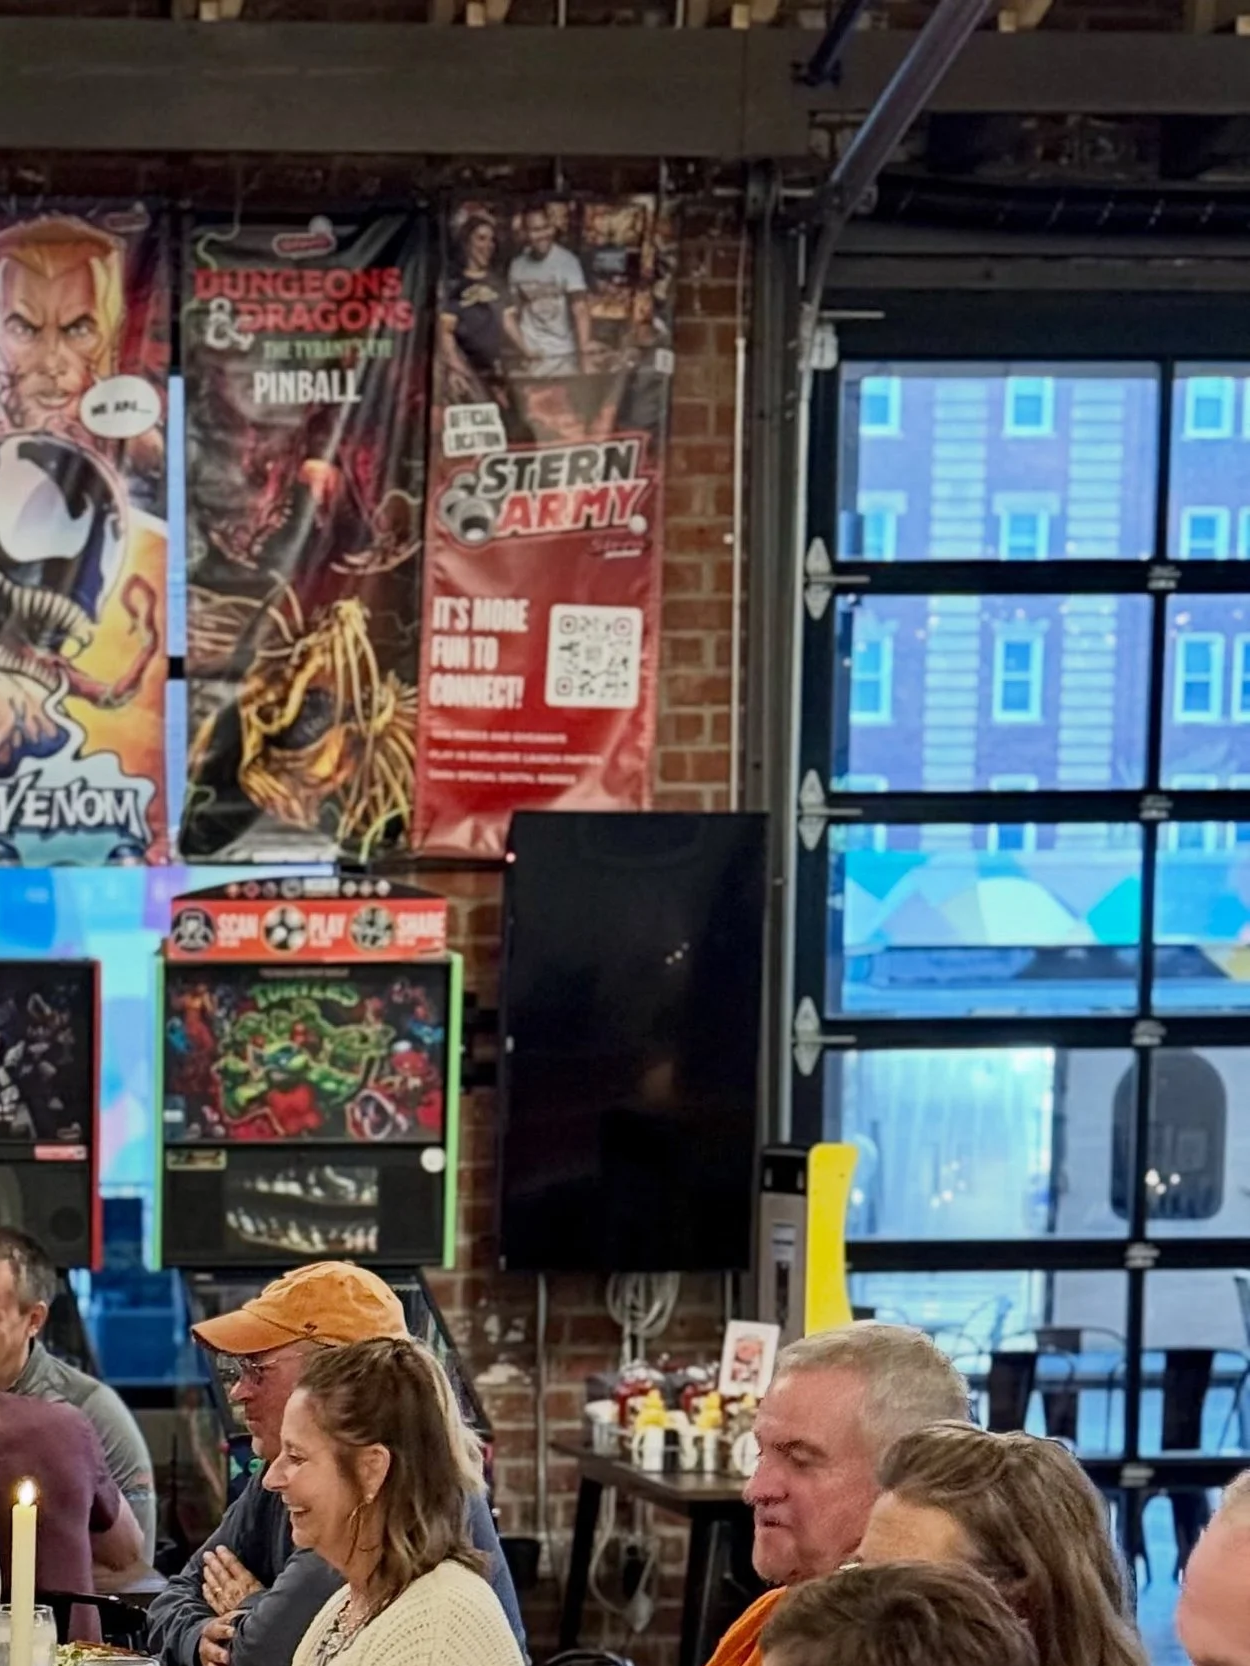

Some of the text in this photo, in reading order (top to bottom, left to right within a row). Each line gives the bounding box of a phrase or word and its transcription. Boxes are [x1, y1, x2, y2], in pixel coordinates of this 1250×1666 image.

[194, 267, 402, 299] DUNGEONS
[206, 298, 414, 351] & DRAGONS
[253, 369, 362, 404] PINBALL
[479, 441, 639, 497] STERN
[496, 481, 646, 536] ARMY
[433, 597, 469, 632] IT'S
[472, 636, 499, 671] TO
